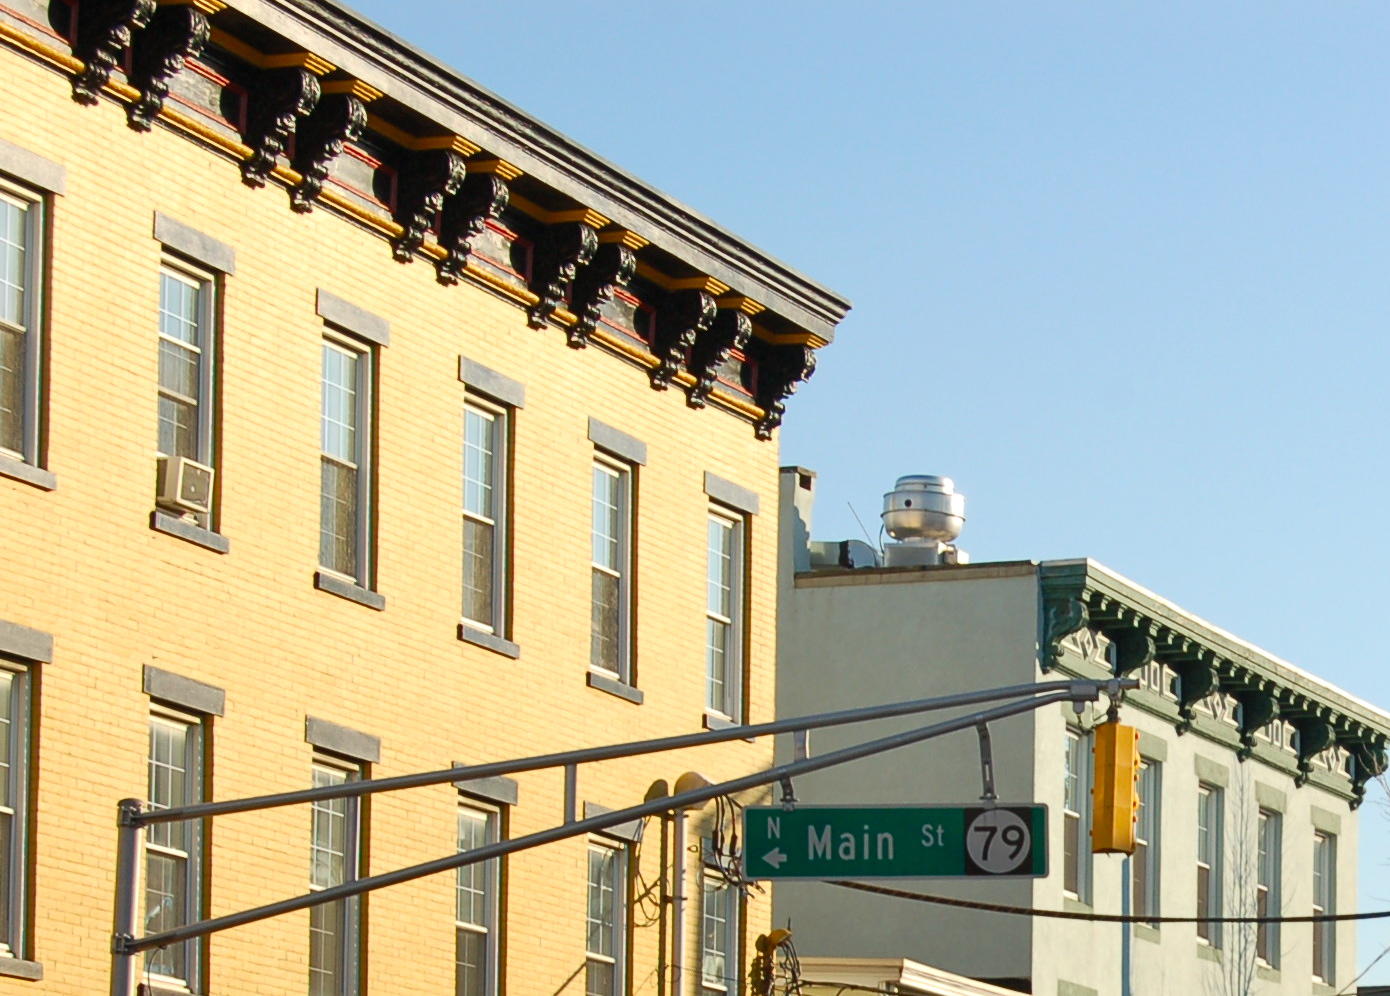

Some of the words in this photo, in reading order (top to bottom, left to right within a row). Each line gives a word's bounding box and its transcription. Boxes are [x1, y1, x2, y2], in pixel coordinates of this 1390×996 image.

[767, 816, 780, 839] N
[807, 824, 894, 861] Main
[921, 824, 945, 847] St
[974, 825, 1025, 861] 79
